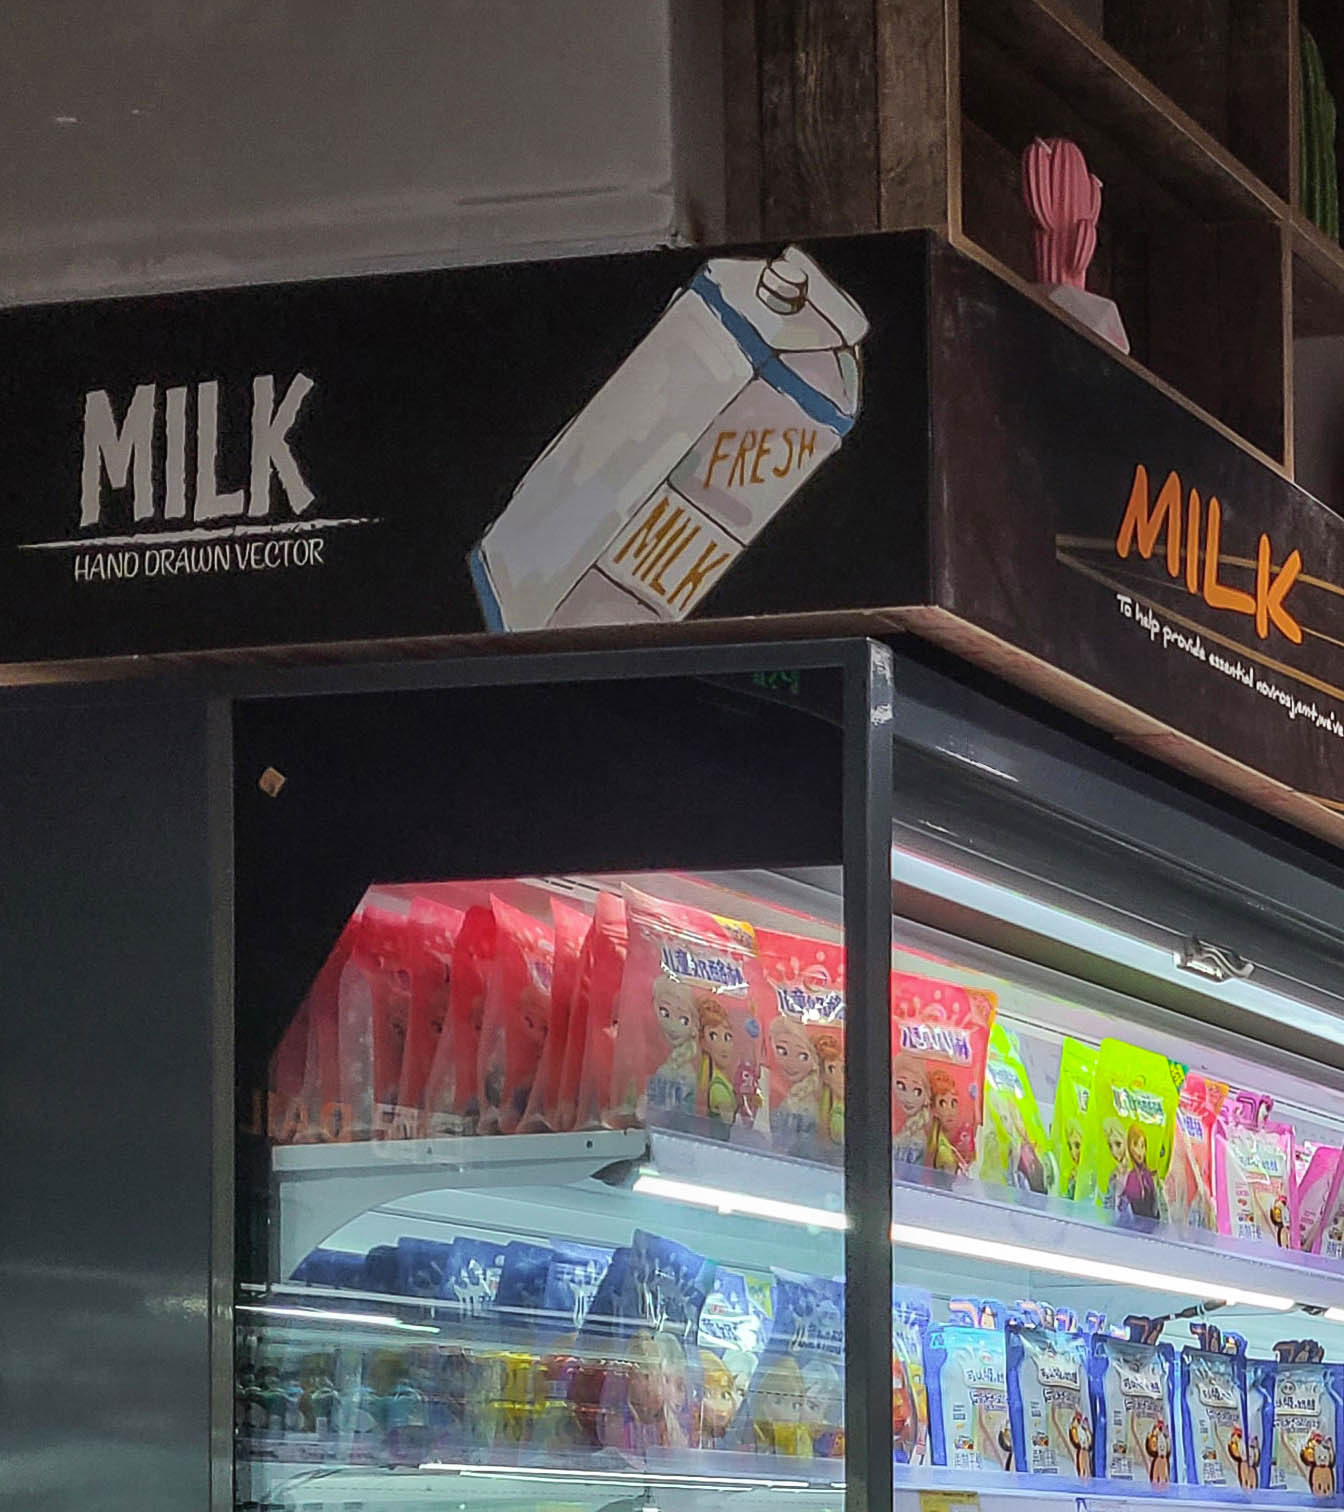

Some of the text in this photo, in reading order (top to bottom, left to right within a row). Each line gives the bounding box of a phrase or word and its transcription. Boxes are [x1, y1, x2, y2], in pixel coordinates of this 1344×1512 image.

[79, 372, 316, 528] MILK
[703, 425, 818, 490] FRESH
[73, 537, 325, 582] HAND DRAWN VECTOR
[614, 497, 732, 613] MILK
[1115, 463, 1303, 645] MILK
[1135, 603, 1161, 641] help
[1163, 626, 1206, 662] provide
[1209, 649, 1254, 689] essential
